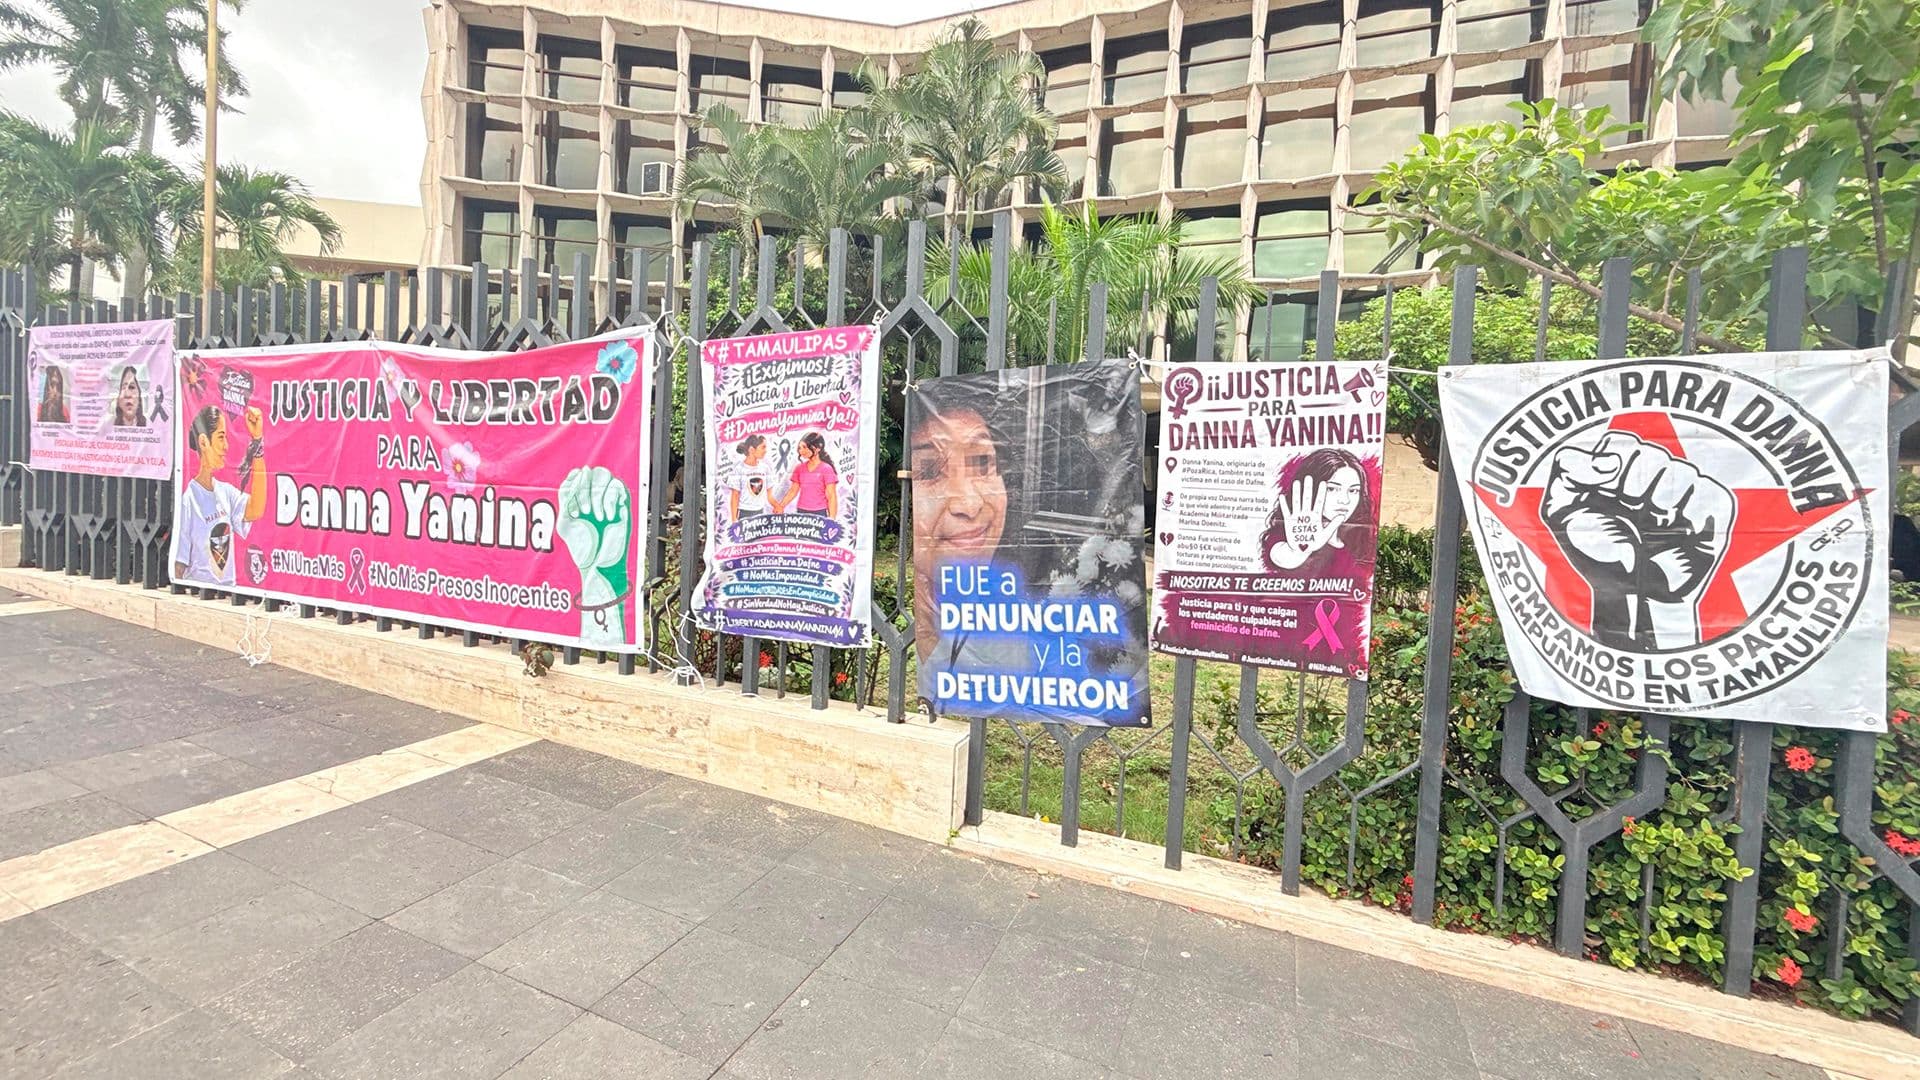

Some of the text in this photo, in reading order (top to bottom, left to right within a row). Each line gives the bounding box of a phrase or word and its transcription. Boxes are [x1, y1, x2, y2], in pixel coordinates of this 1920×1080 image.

[733, 333, 847, 358] TAMAULIPAS
[746, 357, 829, 387] ¡Exigimos!
[271, 375, 621, 425] JUSTICIA Y LIBERTAD
[727, 377, 846, 417] Justicia y Libertad
[774, 402, 794, 412] para
[1249, 400, 1297, 417] PARA
[1169, 412, 1382, 451] DANNA YANINA!!
[1479, 370, 1849, 514] JUSTICIA PARA DANNA
[377, 436, 441, 470] PARA
[1203, 459, 1225, 467] Yanina,
[1226, 460, 1256, 468] originaria
[1182, 467, 1217, 475] #PozaRica,
[275, 473, 556, 552] Danna Yanina
[771, 515, 782, 524] su
[783, 513, 826, 528] inocencia
[1297, 515, 1311, 523] NO
[743, 524, 822, 541] también importa
[1294, 534, 1315, 542] SOLA
[271, 549, 345, 581] #NiUnaMás
[941, 566, 1016, 595] FUE a
[1170, 576, 1354, 592] ¡NOSOTRAS TE CREEMOS DANNA!
[940, 602, 1119, 634] DENUNCIAR
[1178, 608, 1297, 629] los verdaderos culpables del
[1179, 597, 1297, 619] Justicia para ti y que caigan
[1502, 549, 1825, 682] ROMPAMOS LOS PACTOS
[1190, 620, 1281, 638] feminicidio de Dafne.
[1492, 551, 1860, 705] DE IMPUNIDAD EN TAMAULIPAS
[1033, 636, 1081, 672] y la
[937, 672, 1129, 710] DETUVIERON
